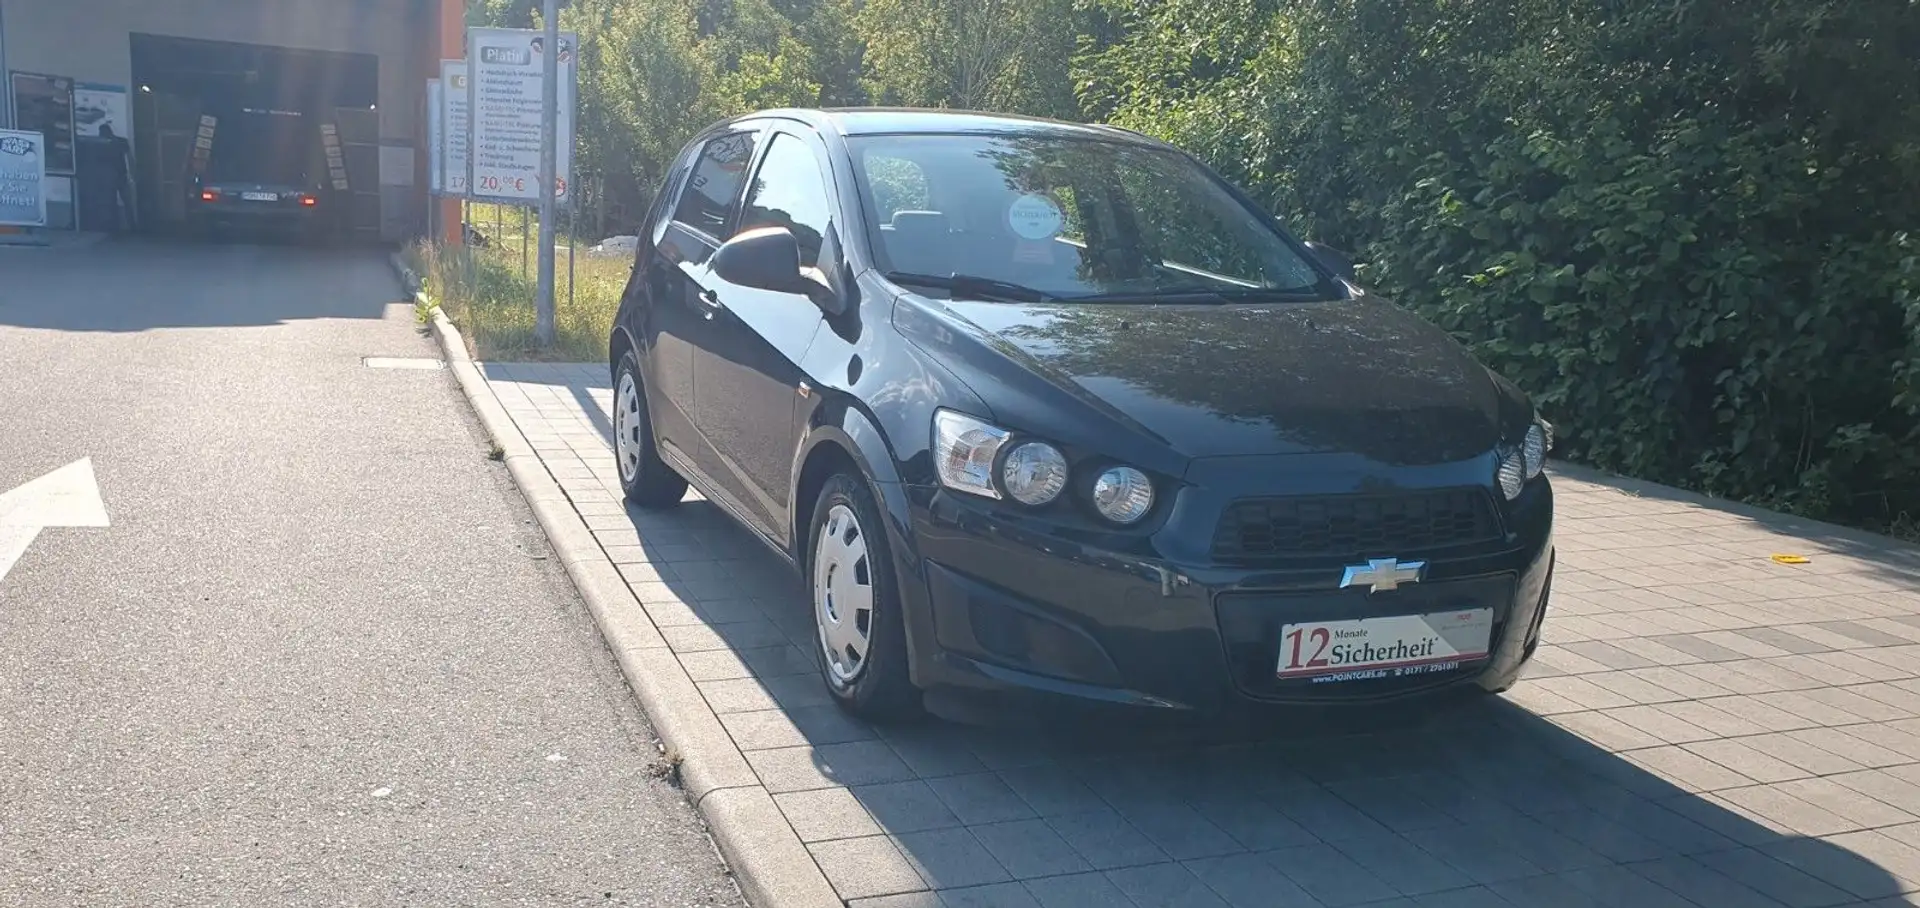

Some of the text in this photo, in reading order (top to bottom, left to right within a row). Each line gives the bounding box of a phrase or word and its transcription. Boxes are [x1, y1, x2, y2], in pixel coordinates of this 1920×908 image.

[487, 48, 524, 62] Platin
[1334, 629, 1368, 639] Monate
[1285, 627, 1330, 669] 12
